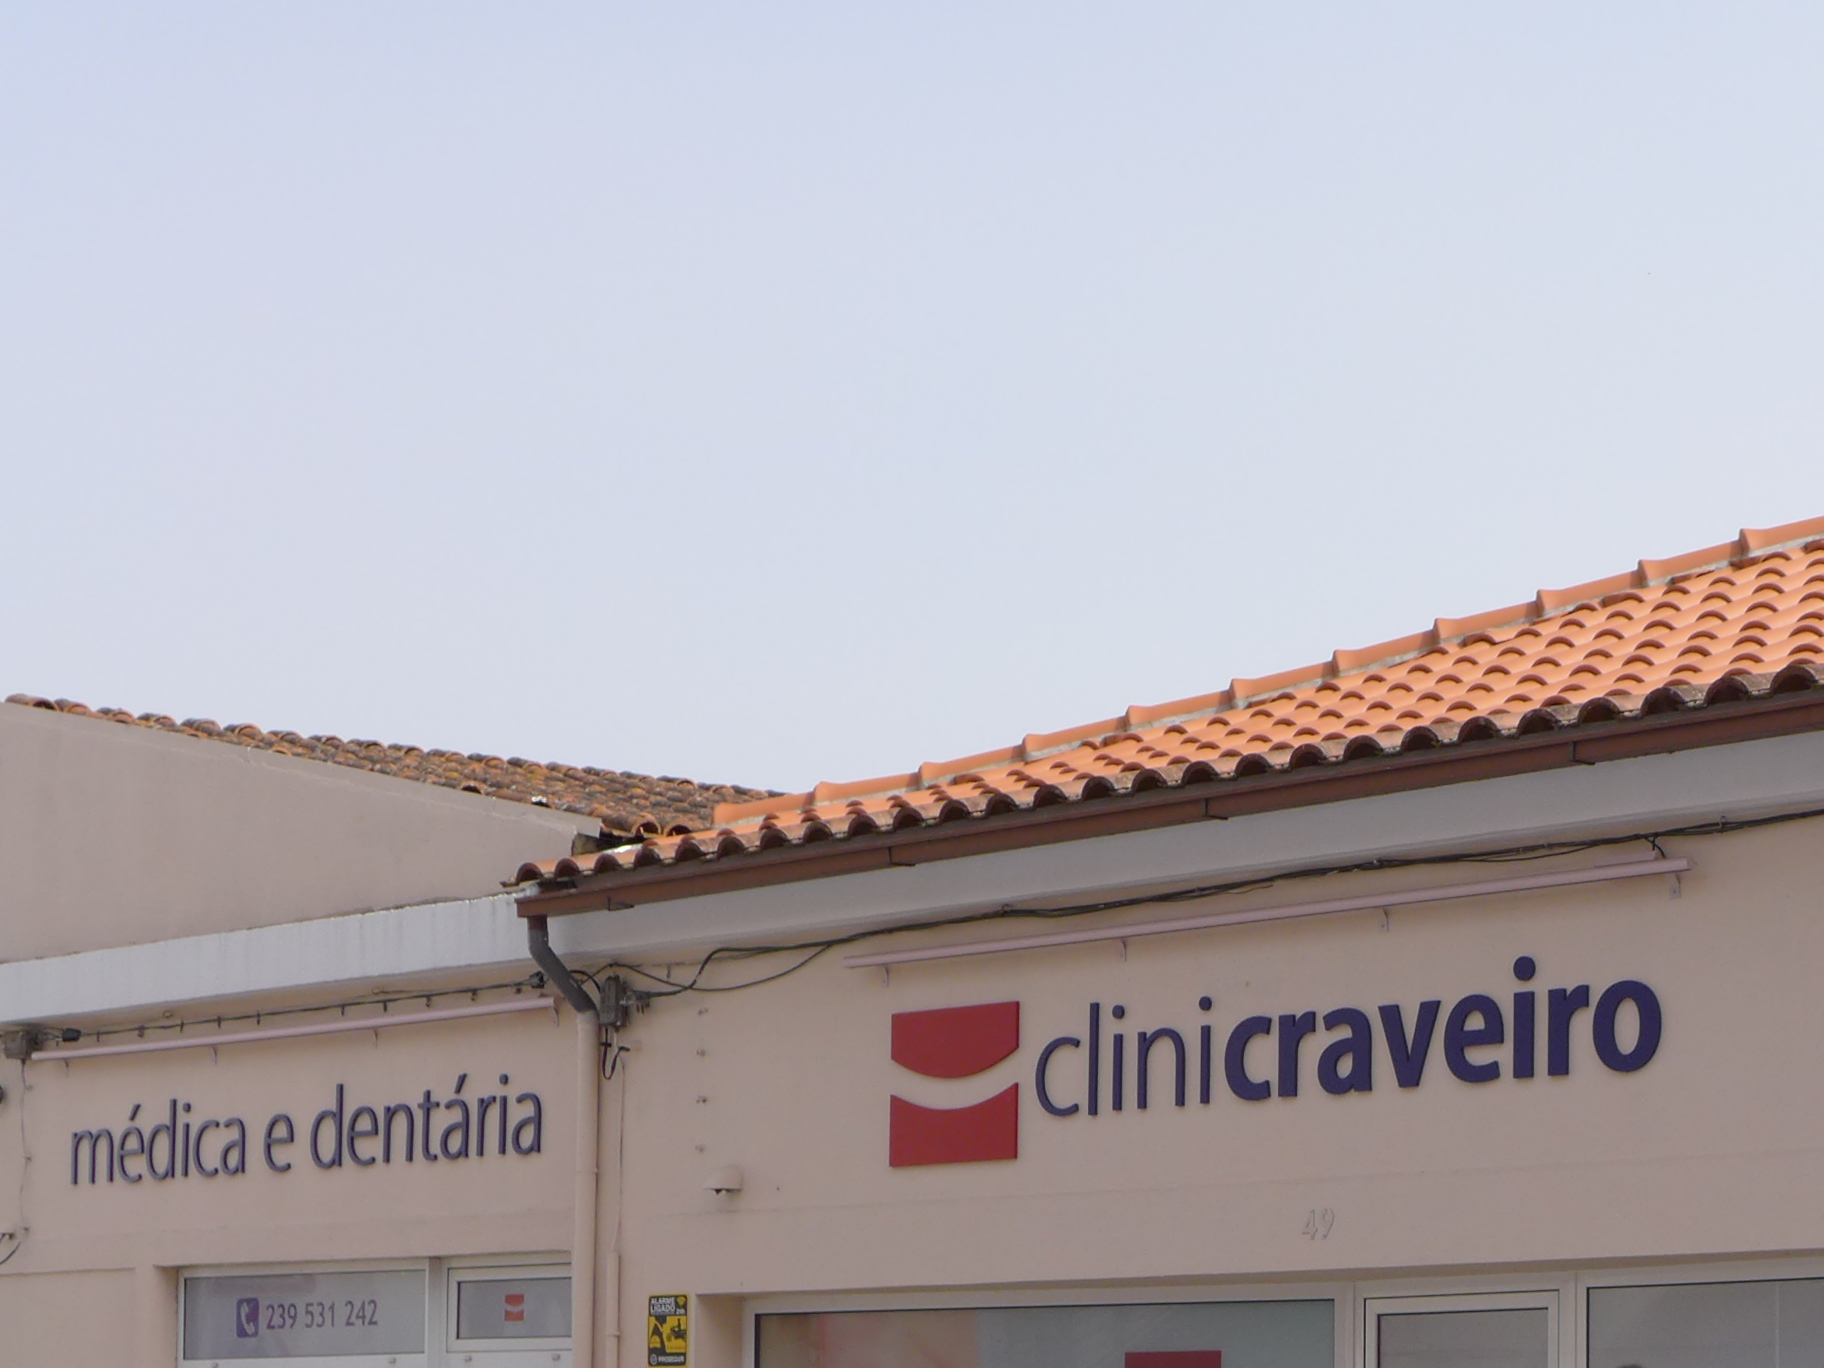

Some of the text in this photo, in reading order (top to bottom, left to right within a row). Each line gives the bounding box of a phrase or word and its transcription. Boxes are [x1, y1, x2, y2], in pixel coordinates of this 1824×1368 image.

[1036, 956, 1662, 1116] clinicraveiro
[70, 1073, 543, 1185] médica e dentária
[1302, 1207, 1335, 1240] 49
[266, 1300, 378, 1330] 239 531 242
